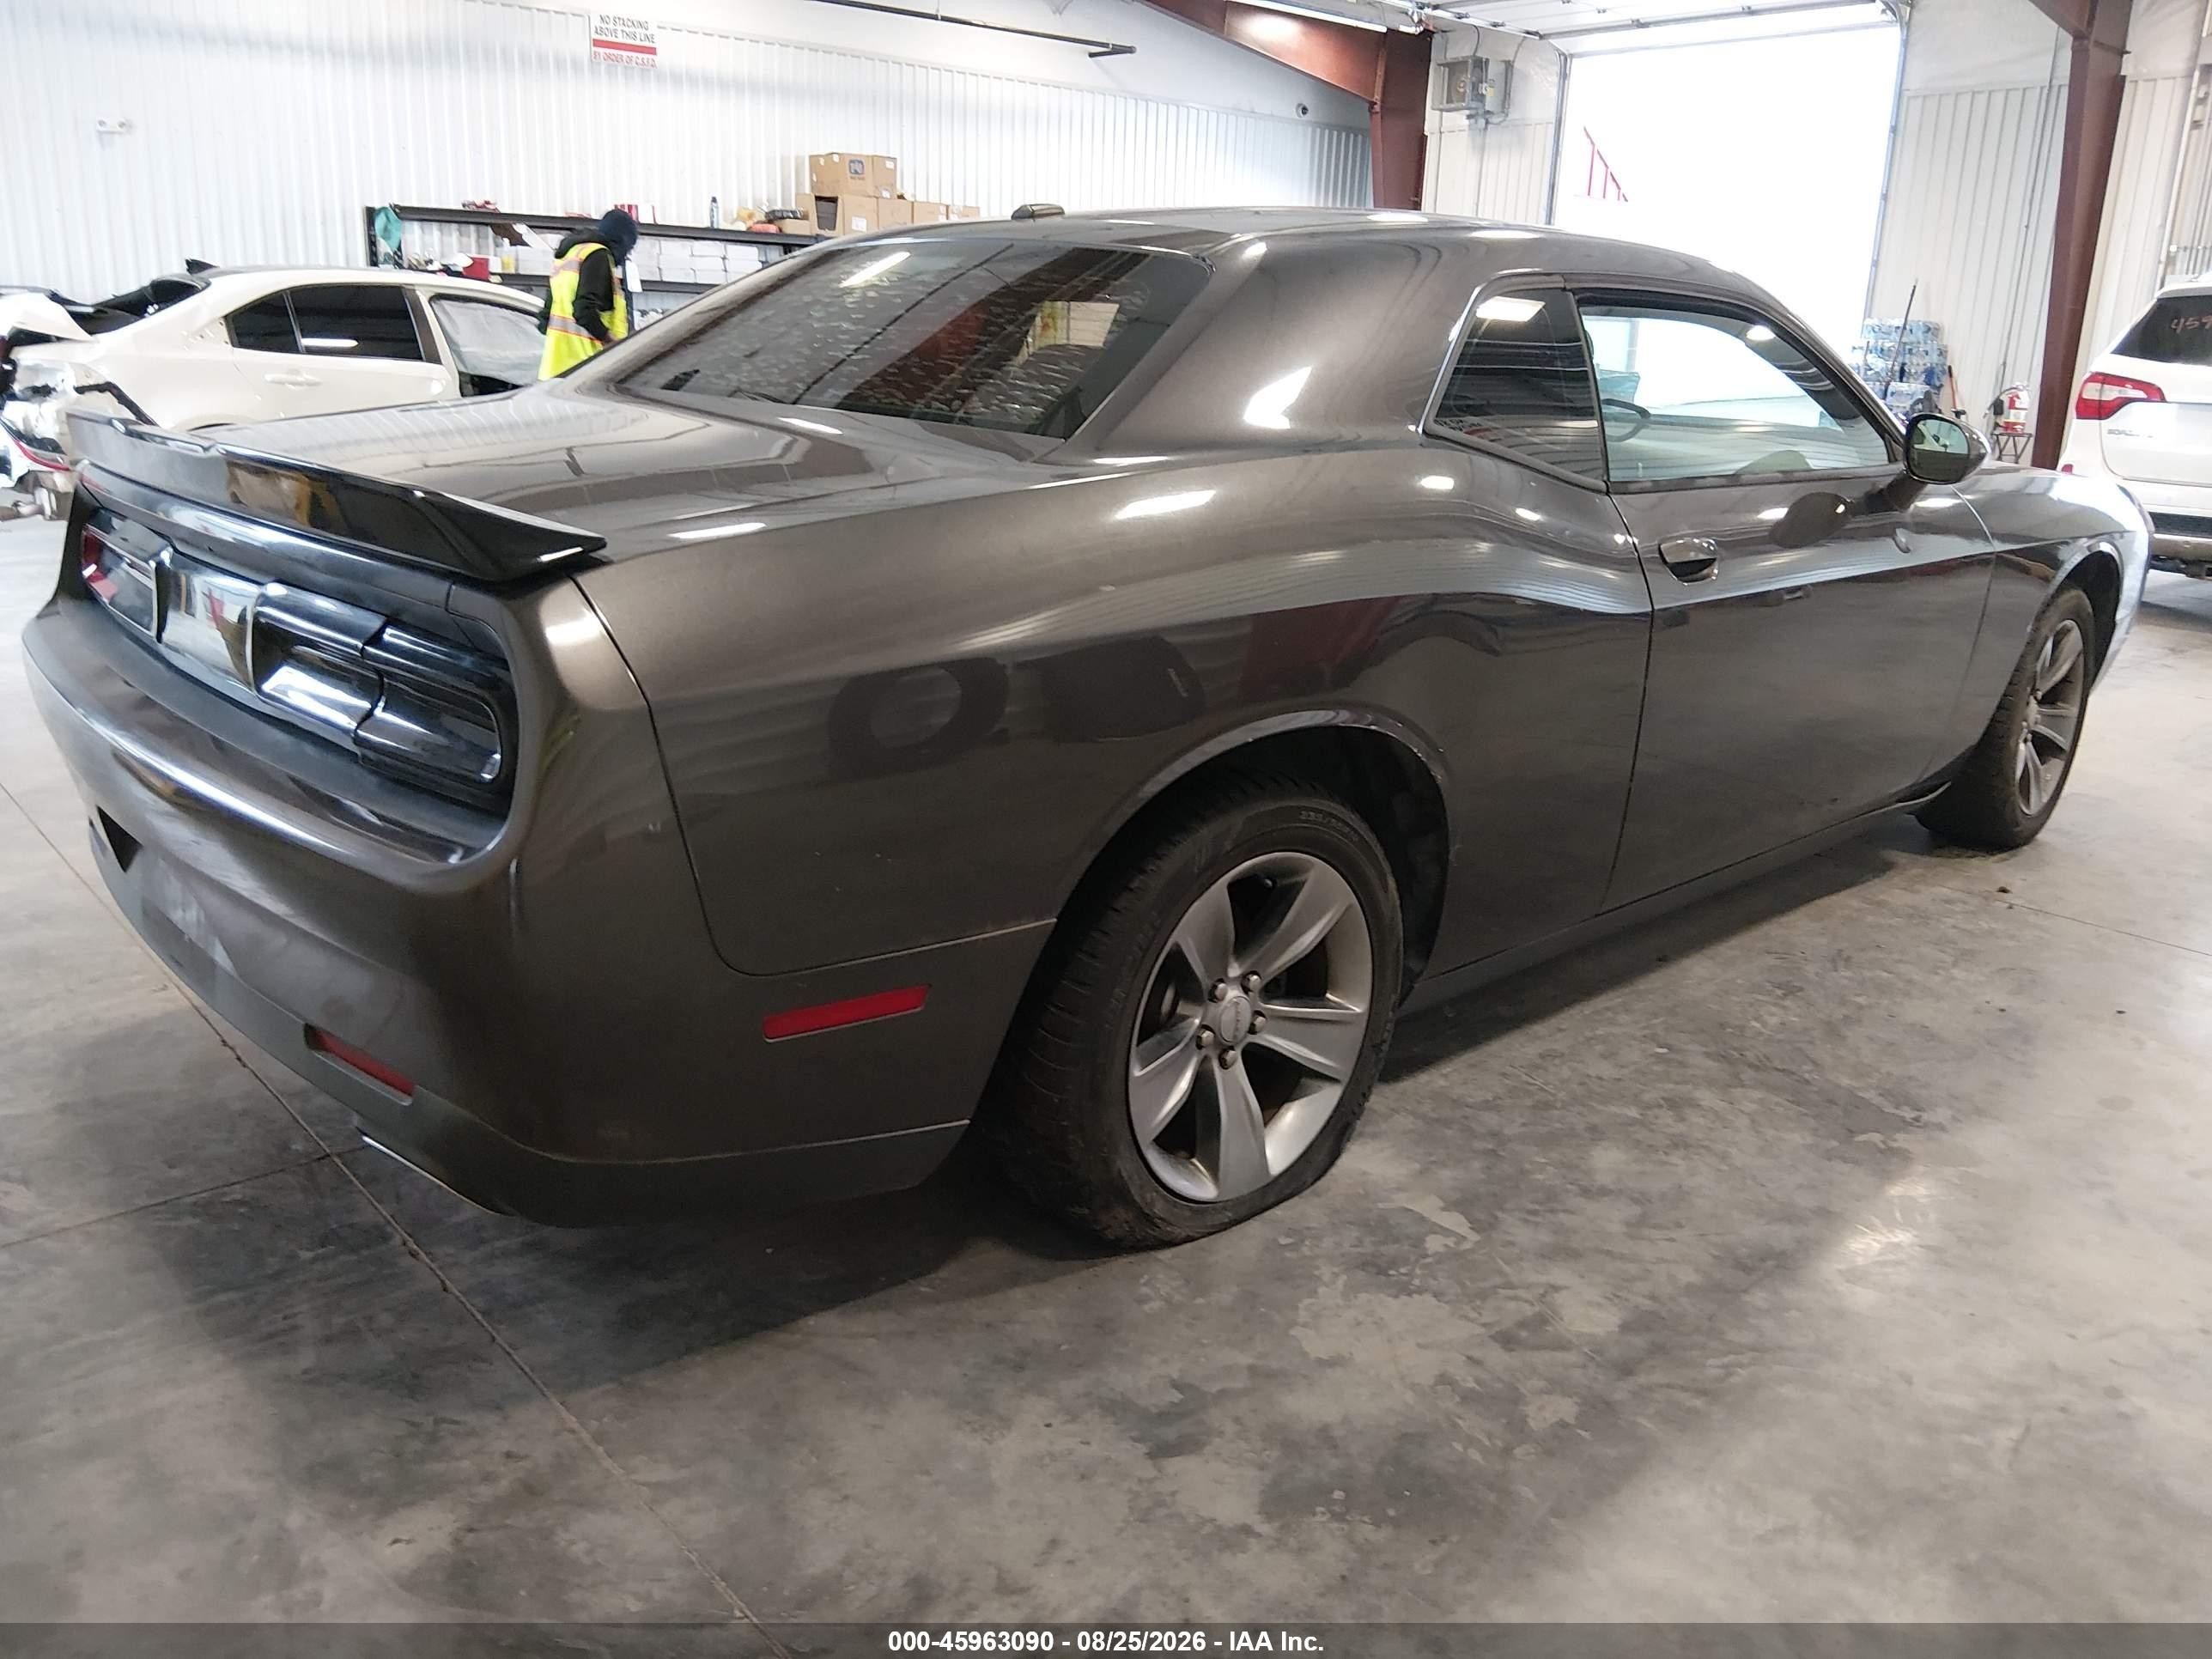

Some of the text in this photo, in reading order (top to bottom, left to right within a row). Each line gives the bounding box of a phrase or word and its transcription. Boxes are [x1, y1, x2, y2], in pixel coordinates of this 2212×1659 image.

[599, 15, 648, 31] NO STACKING
[594, 26, 655, 44] ABOVE THIS LINE
